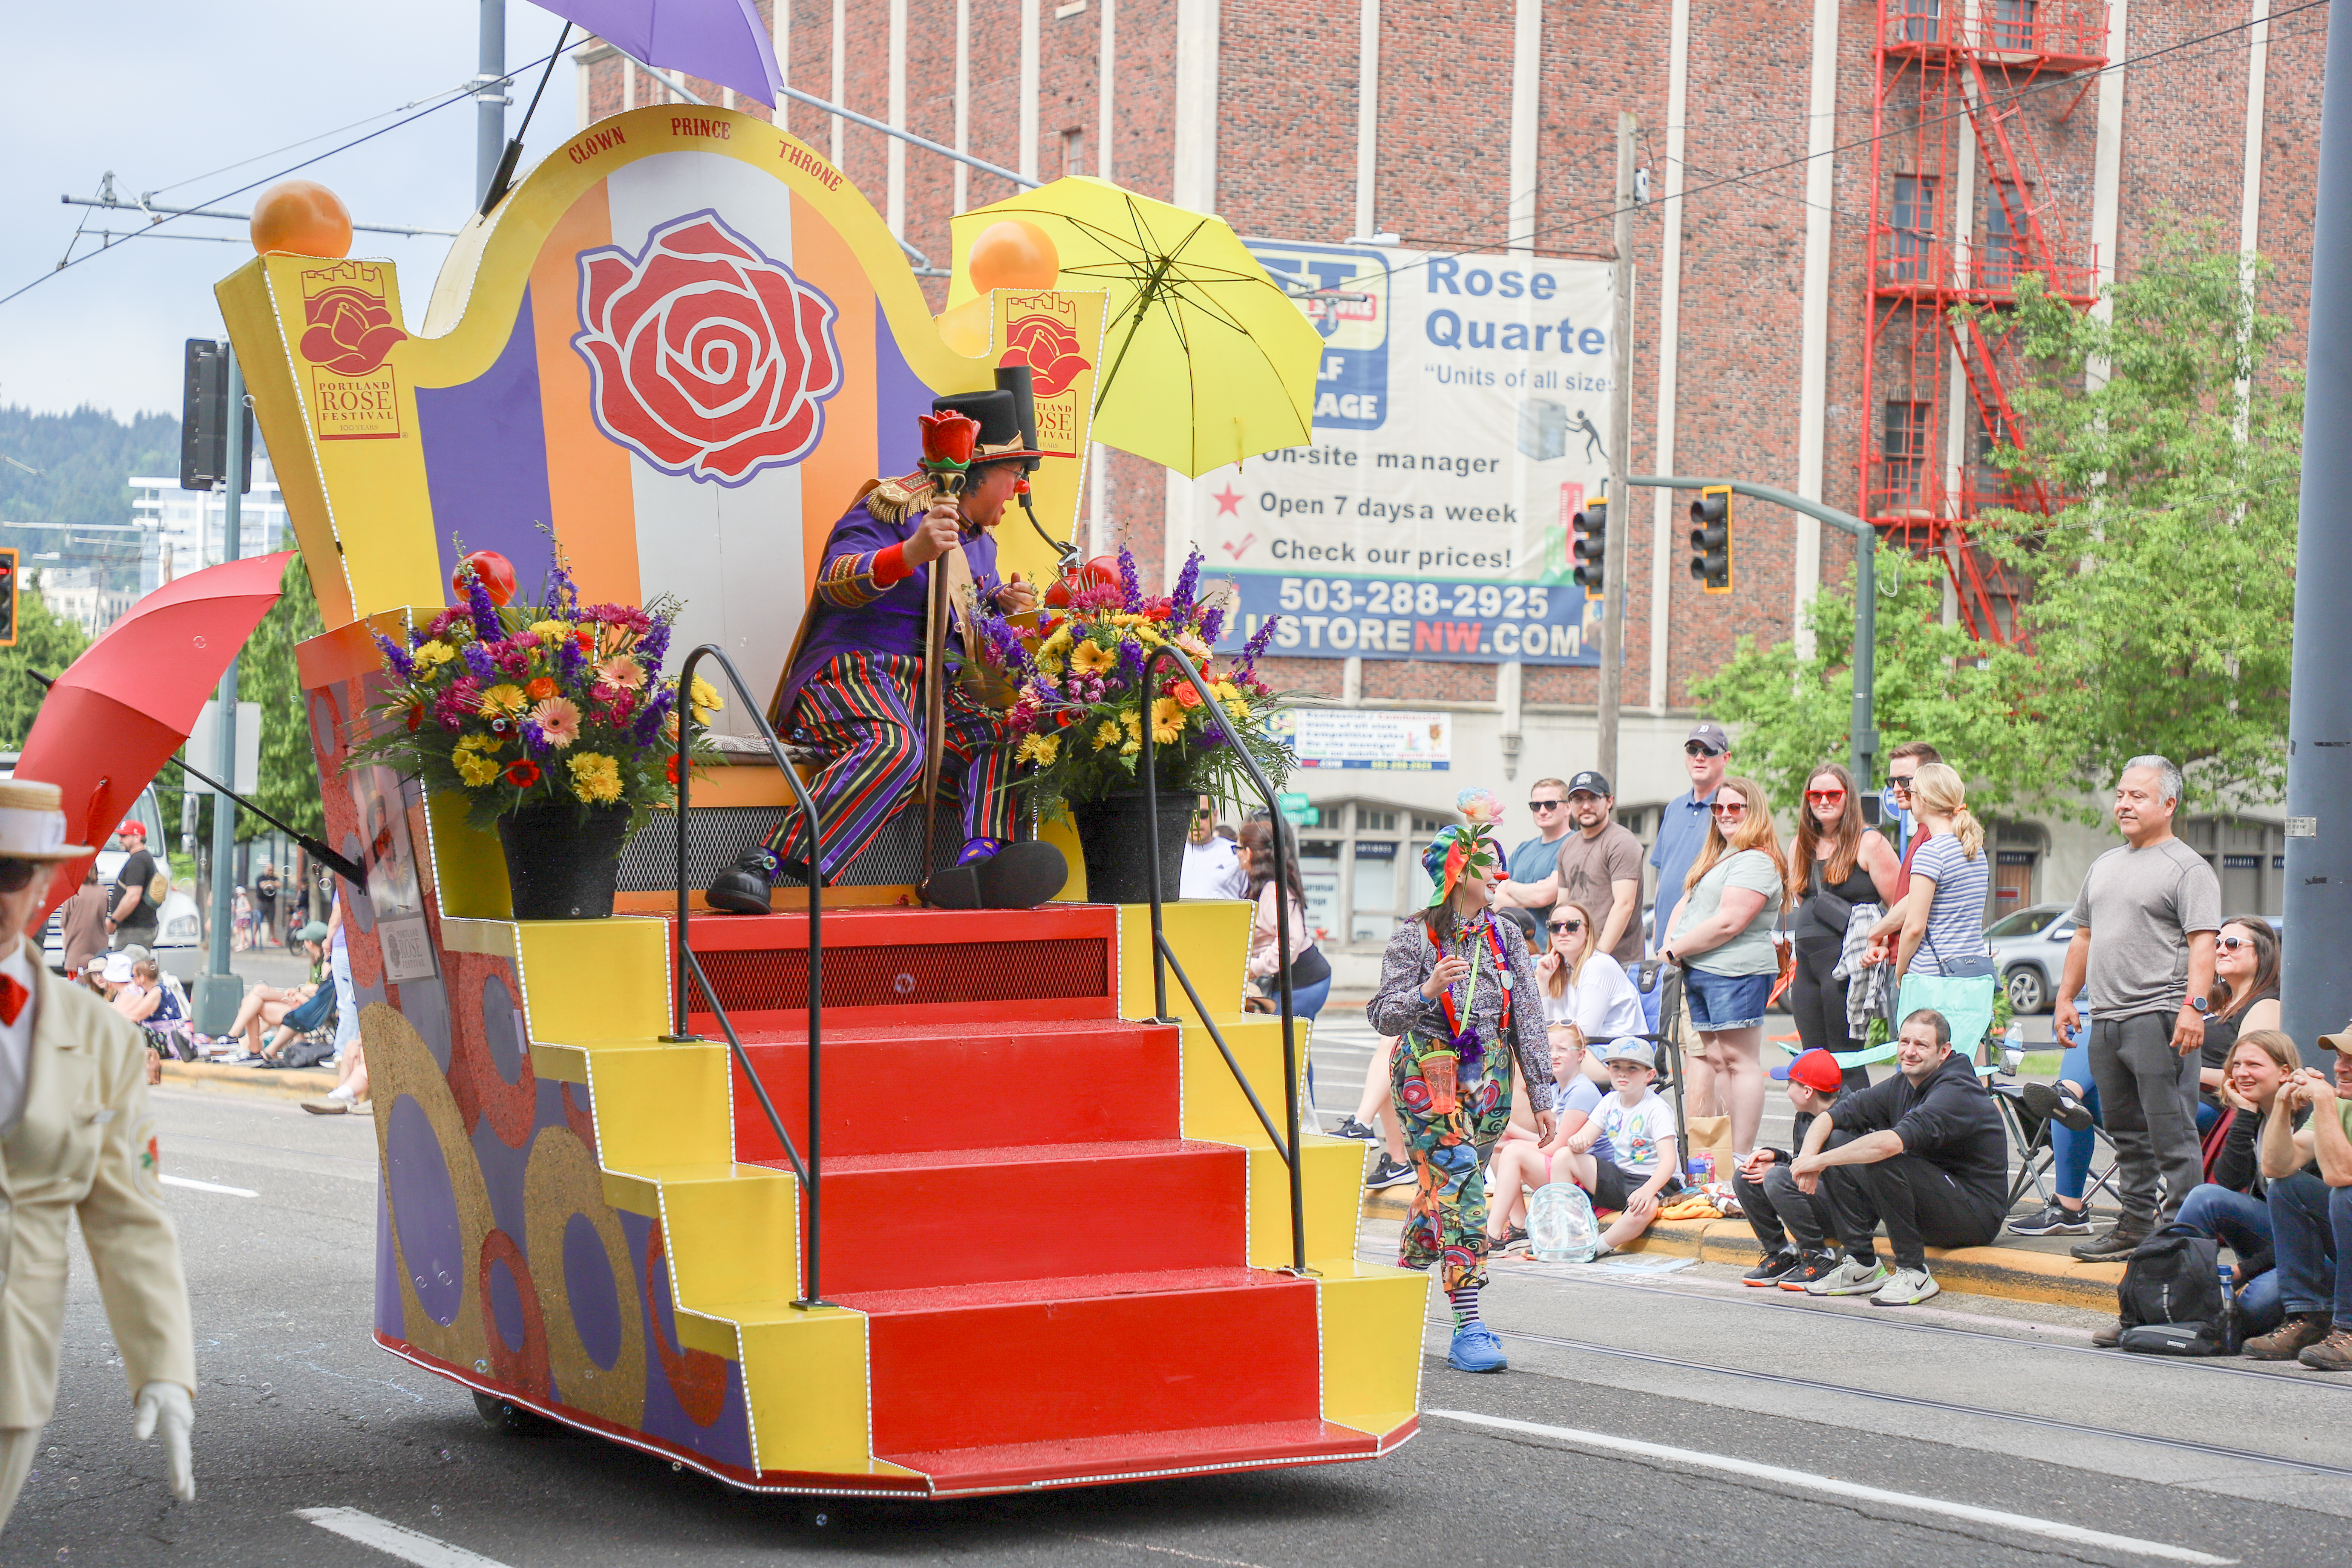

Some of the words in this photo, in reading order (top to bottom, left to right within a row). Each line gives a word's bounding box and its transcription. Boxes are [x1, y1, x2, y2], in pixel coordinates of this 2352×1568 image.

[568, 126, 626, 165] CLOWN
[671, 117, 731, 140] PRINCE
[779, 139, 843, 192] THRONE
[1427, 256, 1557, 300] Rose
[1426, 309, 1614, 355] Quarte
[319, 381, 390, 391] PORTLAND
[1505, 368, 1527, 387] of
[1534, 370, 1557, 389] all
[320, 390, 391, 411] ROSE
[1035, 402, 1072, 413] TLAND
[322, 412, 393, 421] FESTIVAL
[1034, 410, 1071, 431] OSE
[1037, 430, 1072, 440] TIVAL
[1377, 451, 1500, 477] manager
[1260, 492, 1324, 518] Open
[1334, 496, 1348, 515] 7
[1446, 504, 1517, 523] week
[1271, 539, 1355, 562] Check
[1367, 548, 1410, 564] our
[1419, 547, 1512, 570] prices!
[1279, 577, 1549, 619] 503-288-2925
[2224, 858, 2254, 867] ANTIQUES
[398, 938, 423, 958] ROSE
[402, 959, 425, 969] FESTIVAL
